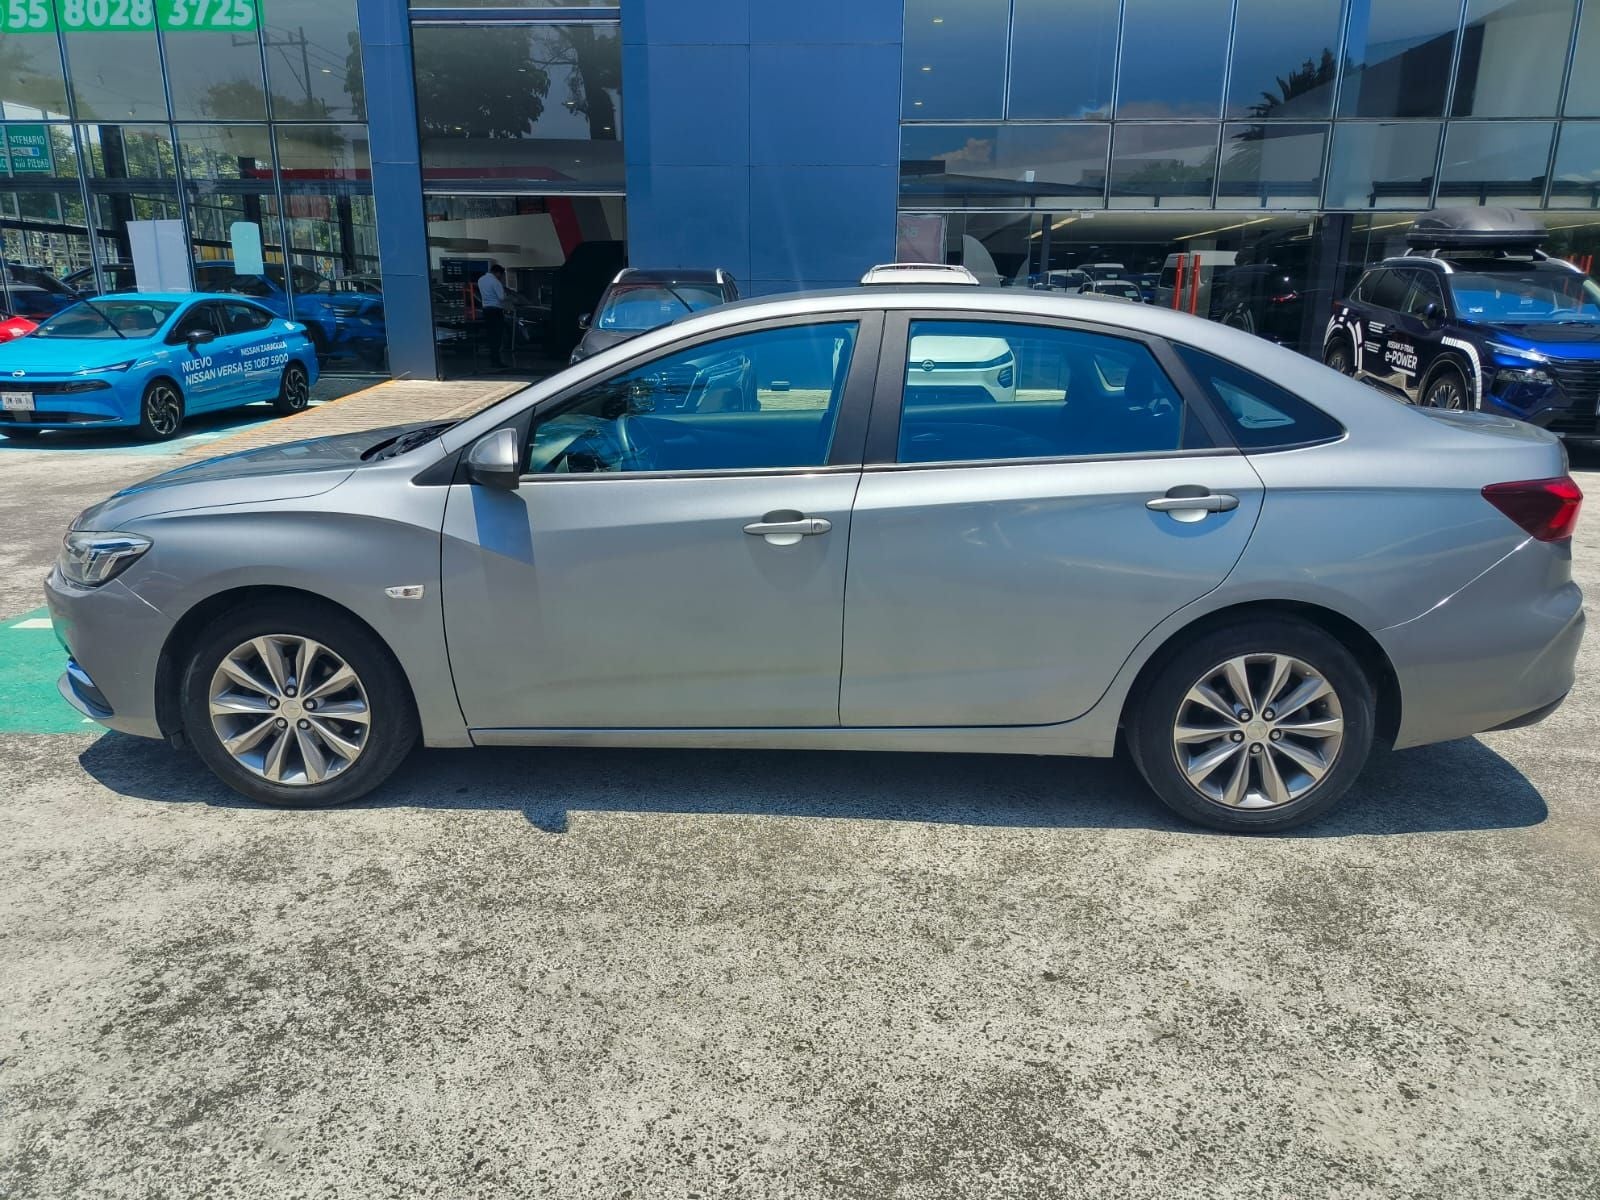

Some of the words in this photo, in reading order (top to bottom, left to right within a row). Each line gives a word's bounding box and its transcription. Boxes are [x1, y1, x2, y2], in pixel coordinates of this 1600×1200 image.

[8, 0, 48, 28] 55
[64, 0, 152, 26] 8028
[168, 0, 254, 26] 3725
[241, 345, 260, 356] NISSAN
[261, 341, 287, 352] ZARAGOZA
[182, 356, 212, 372] NUEVO
[244, 360, 252, 372] 55
[254, 357, 269, 369] 1087
[271, 353, 288, 365] 5900
[1385, 350, 1417, 369] e-POWER
[186, 369, 215, 386] NISSAN
[217, 362, 243, 377] VERSA
